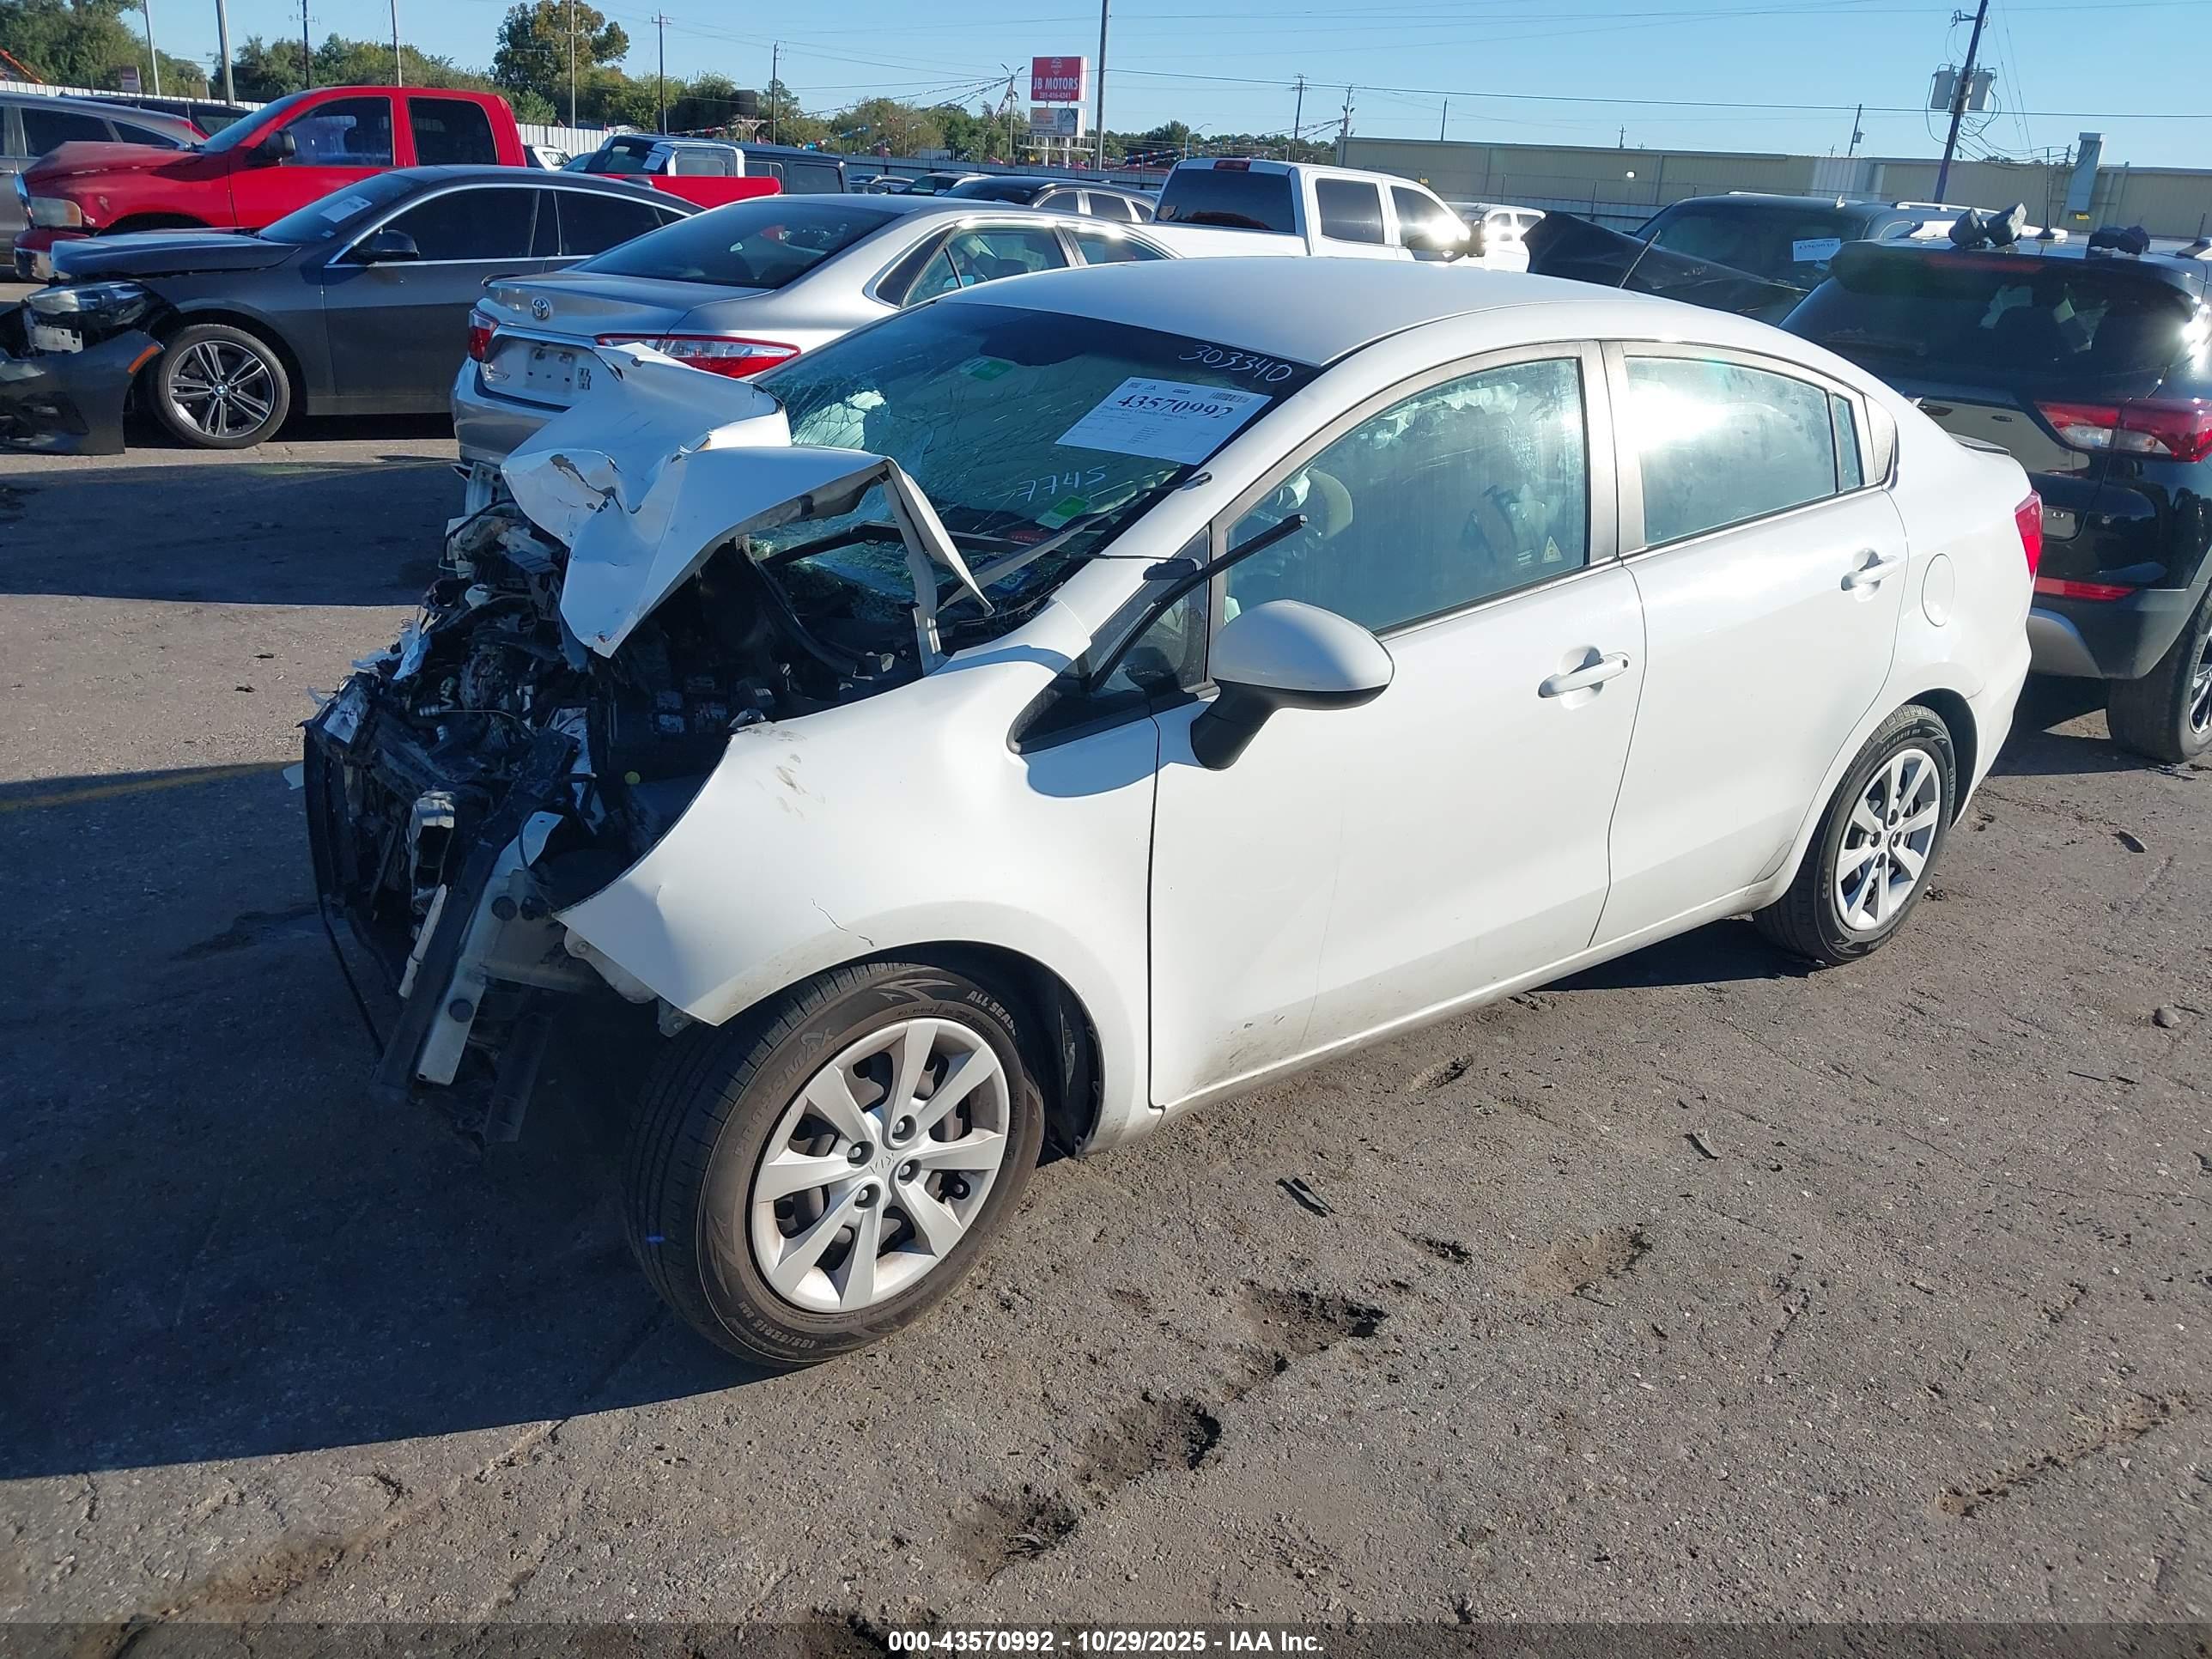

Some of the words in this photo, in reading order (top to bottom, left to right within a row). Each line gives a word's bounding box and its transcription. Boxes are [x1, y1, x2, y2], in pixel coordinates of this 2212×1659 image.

[1033, 77, 1042, 90] JB
[1045, 77, 1079, 90] MOTORS
[1178, 344, 1292, 381] 303340
[1117, 394, 1234, 418] 43570992
[1017, 465, 1107, 501] 7745
[967, 990, 989, 1006] ALL
